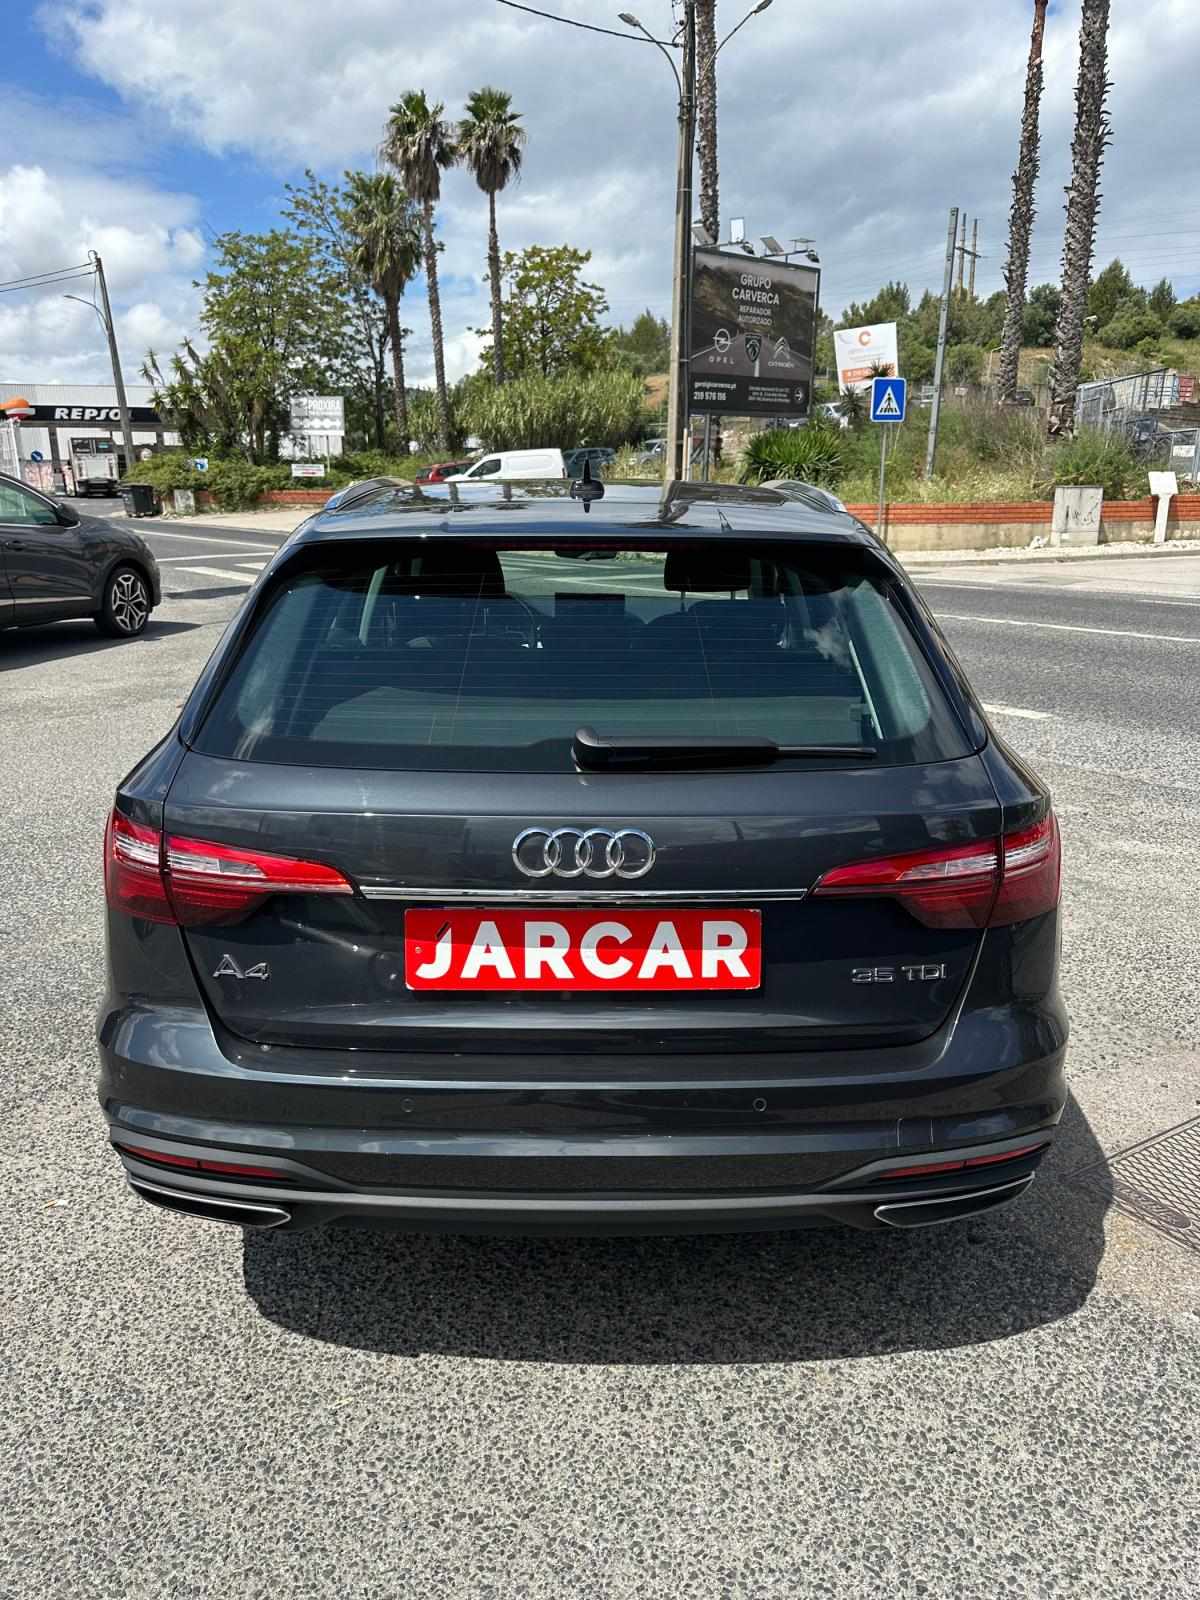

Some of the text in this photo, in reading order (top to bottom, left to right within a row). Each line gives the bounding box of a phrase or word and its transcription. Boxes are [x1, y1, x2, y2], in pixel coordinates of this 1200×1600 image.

[740, 273, 772, 289] GRUPO
[731, 287, 780, 305] CARVERCA
[739, 304, 772, 316] REPARADOR
[708, 355, 735, 365] OPEL
[415, 920, 752, 980] JARCAR
[212, 953, 269, 980] A4
[851, 963, 947, 983] 35 TDI
